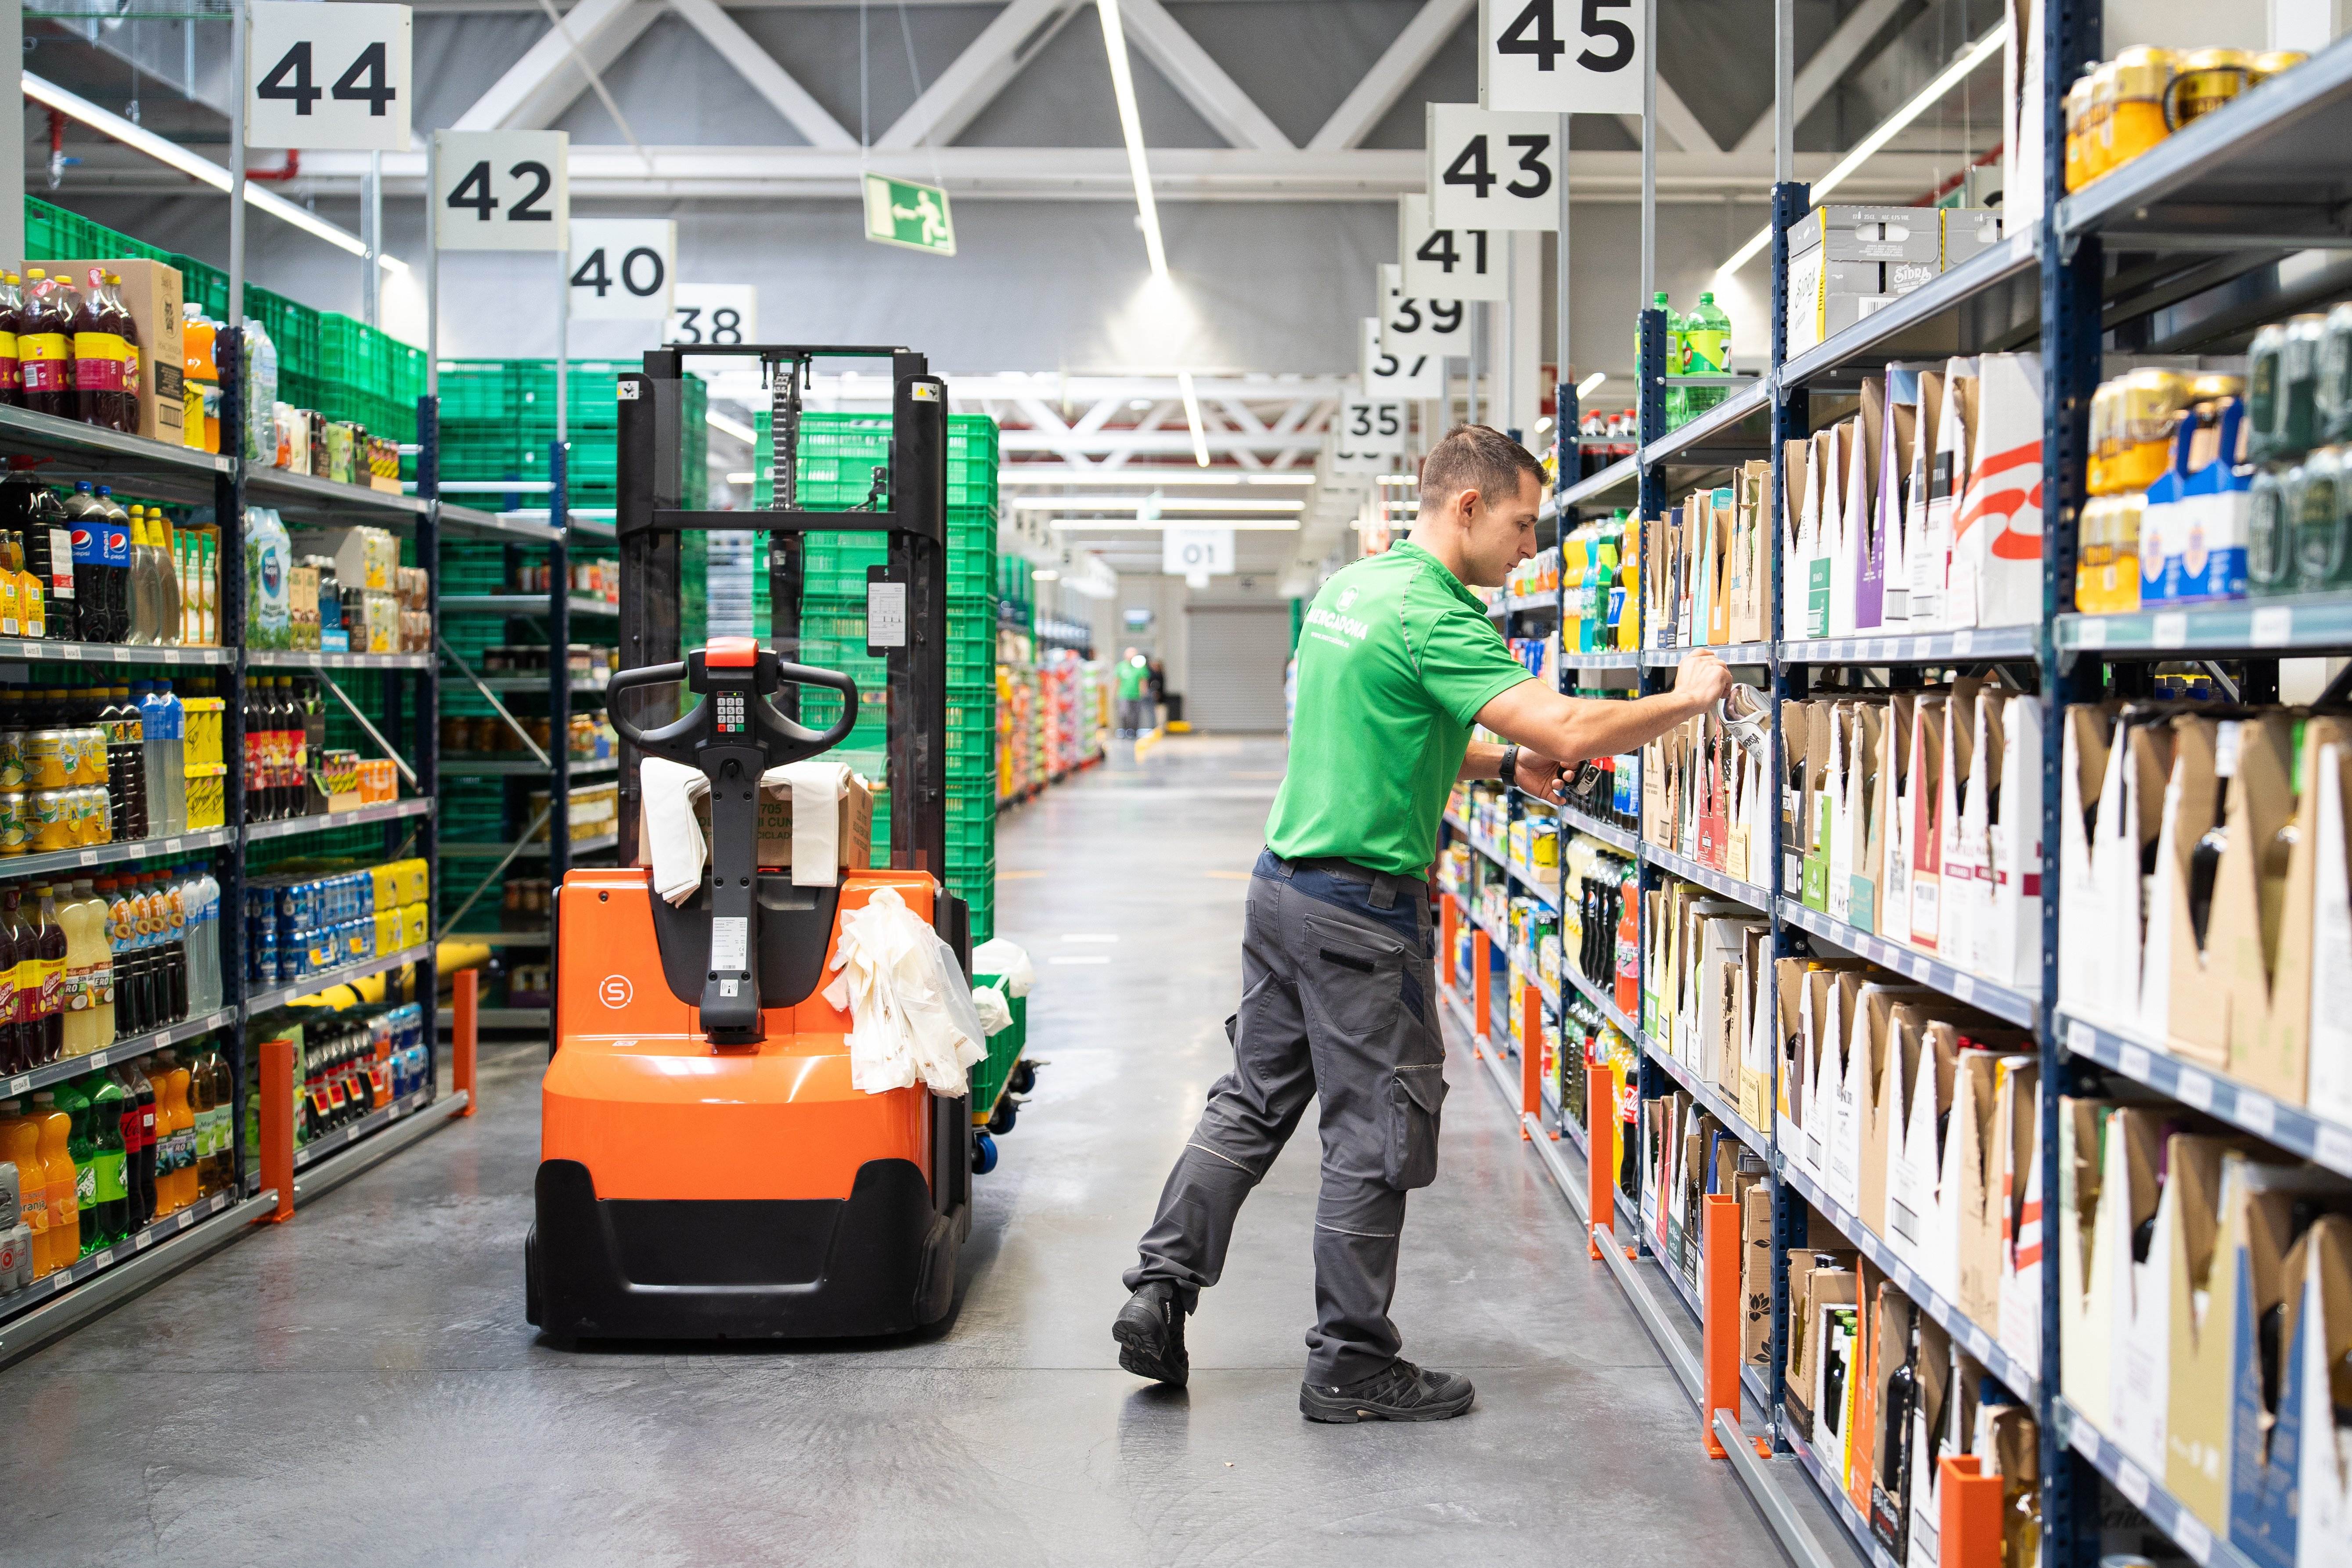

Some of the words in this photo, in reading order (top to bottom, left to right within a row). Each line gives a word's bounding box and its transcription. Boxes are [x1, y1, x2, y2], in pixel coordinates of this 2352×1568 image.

[1497, 0, 1635, 72] 45
[257, 41, 396, 116] 44
[1443, 134, 1552, 198] 43
[447, 161, 552, 221] 42
[570, 248, 664, 296] 40
[1416, 231, 1487, 274] 41
[675, 308, 742, 344] 38
[1391, 290, 1463, 333] 39
[1351, 405, 1399, 436] 35
[1184, 543, 1216, 568] 01
[761, 804, 782, 815] 705
[1685, 1240, 1696, 1262] IRISH
